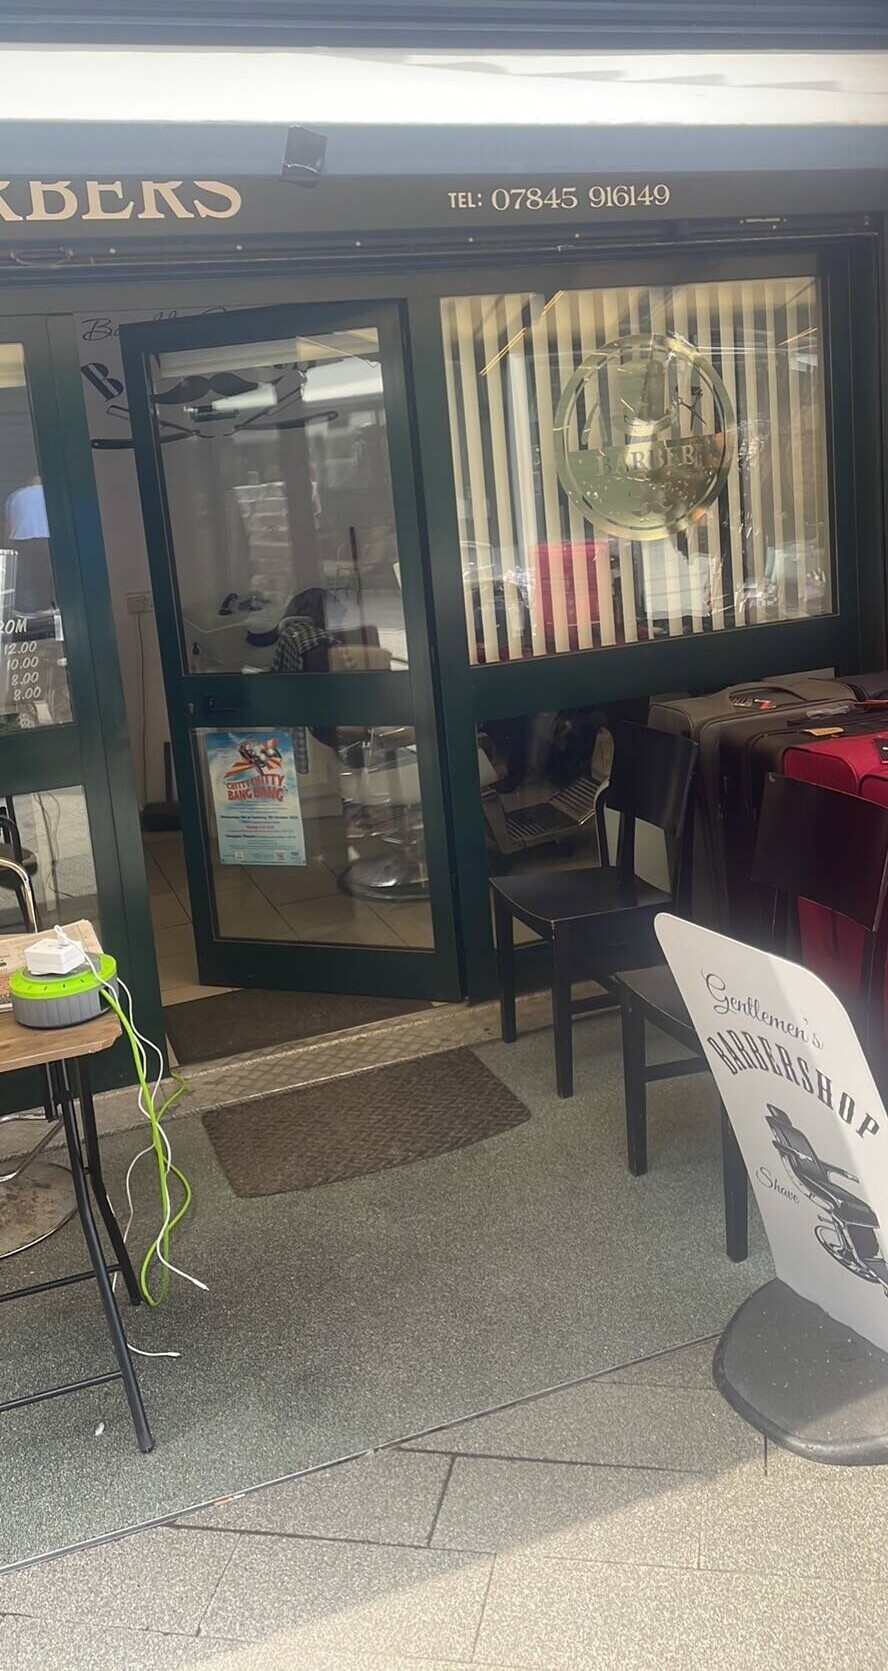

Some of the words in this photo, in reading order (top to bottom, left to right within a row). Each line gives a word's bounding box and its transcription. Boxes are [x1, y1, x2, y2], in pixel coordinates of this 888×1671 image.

[0, 181, 242, 221] BERS
[448, 192, 483, 208] TEL:
[491, 187, 578, 211] 07845
[588, 184, 671, 208] 916149
[4, 641, 37, 655] 12.00
[7, 656, 39, 671] 10.00
[11, 671, 39, 686] 8.00
[13, 686, 41, 701] 8.00
[226, 779, 250, 790] CHITTY
[250, 773, 285, 788] CHITTY
[227, 788, 253, 801] BANG
[701, 969, 824, 1050] Gentlemen's
[706, 1029, 880, 1139] BARBERSHOP
[755, 1166, 800, 1204] Shave
